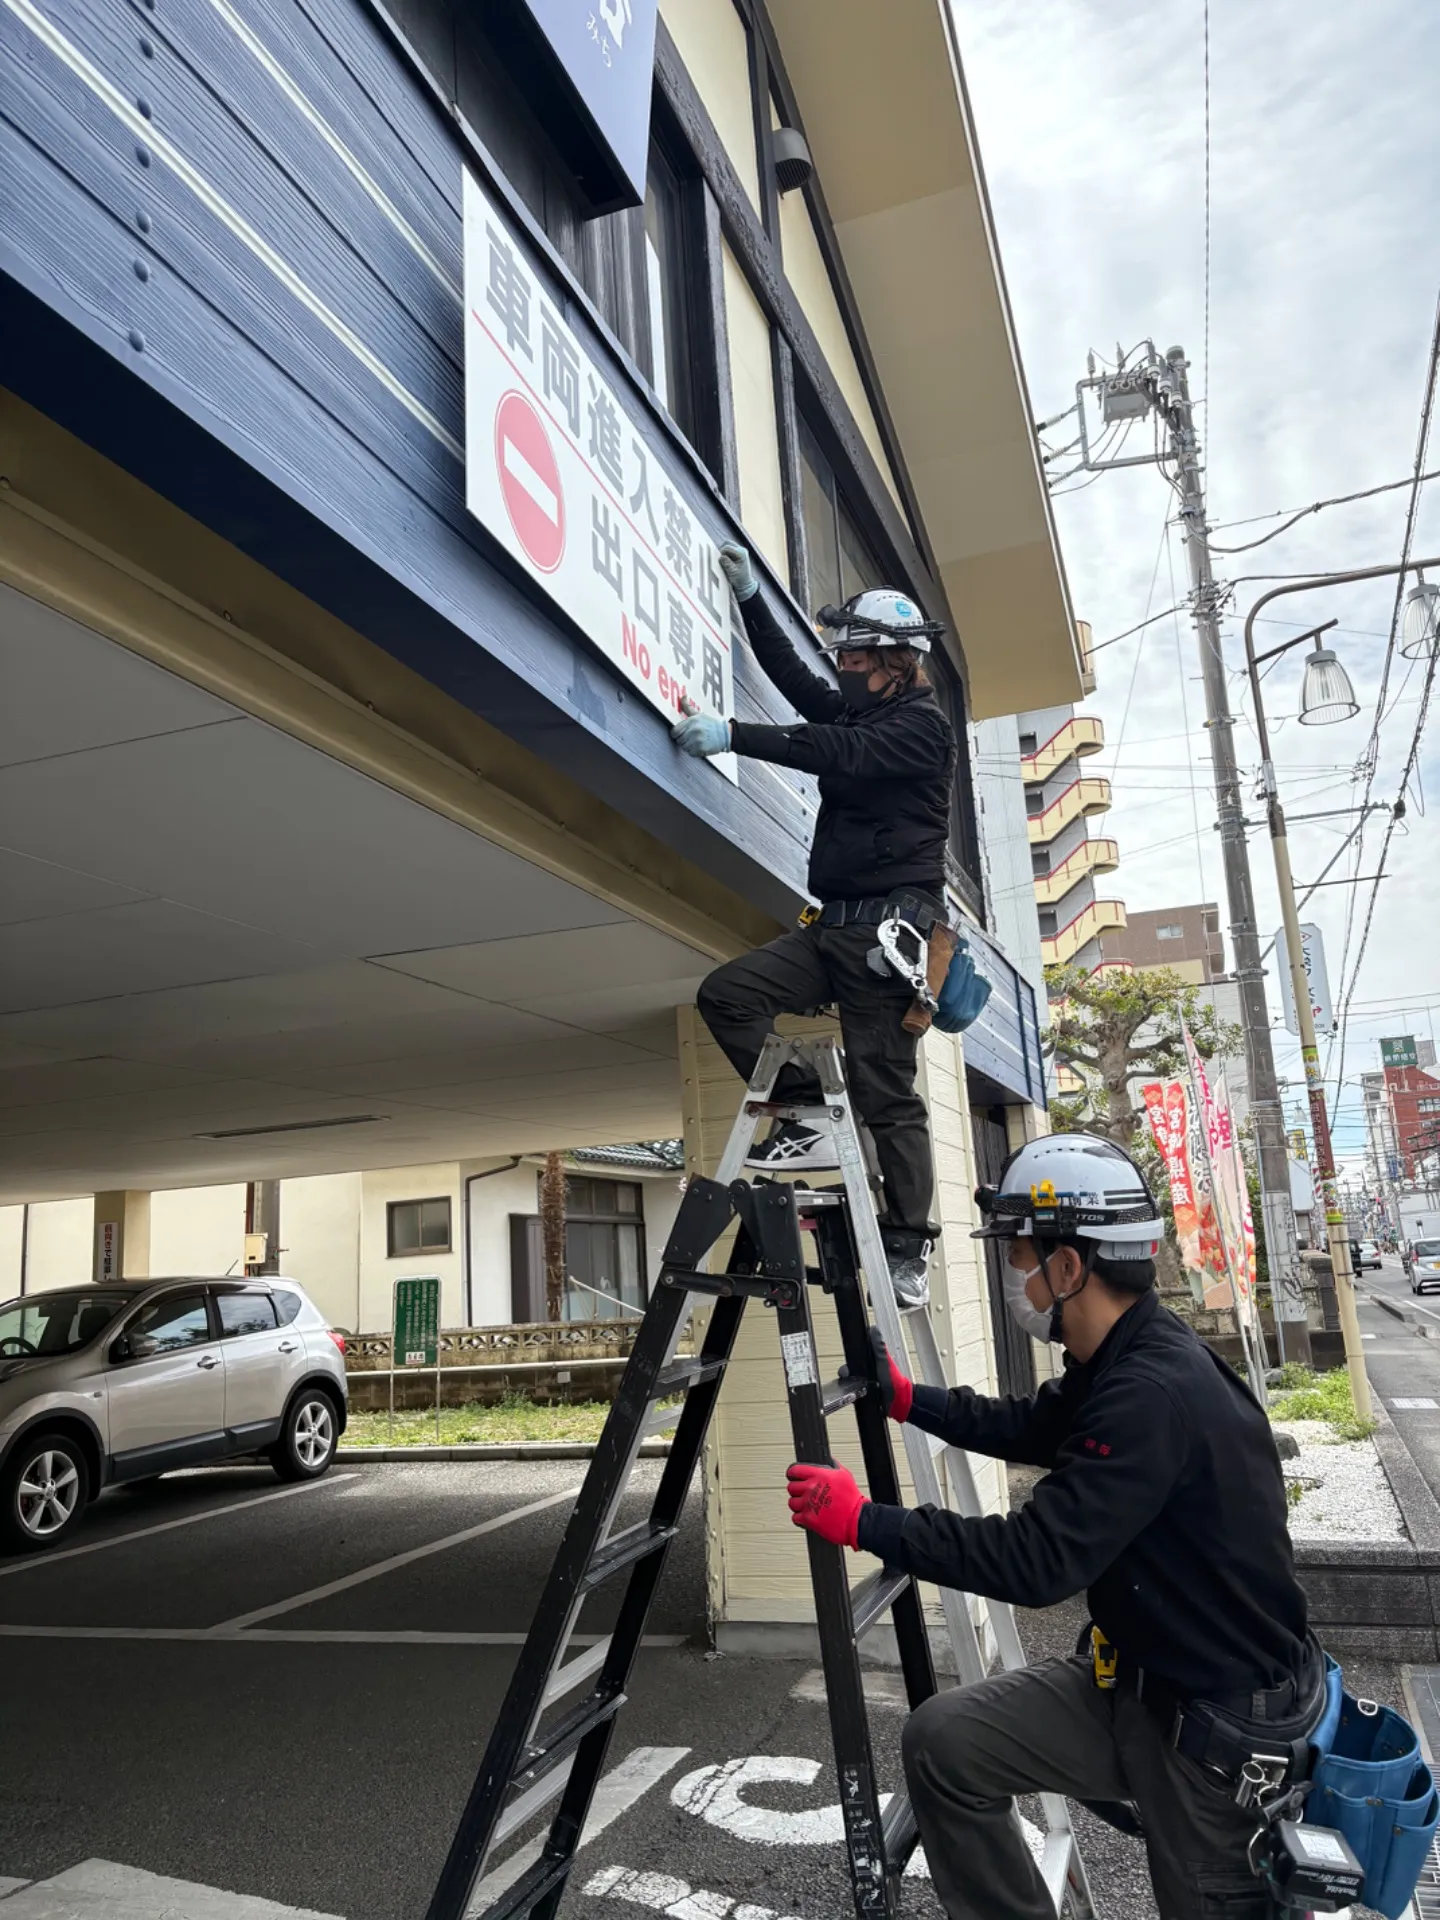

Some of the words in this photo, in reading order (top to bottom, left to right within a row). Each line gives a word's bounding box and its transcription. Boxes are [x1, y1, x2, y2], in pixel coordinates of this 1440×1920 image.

[485, 219, 723, 628] 車両進入禁止
[591, 494, 724, 717] 出口専用
[621, 611, 651, 680] No
